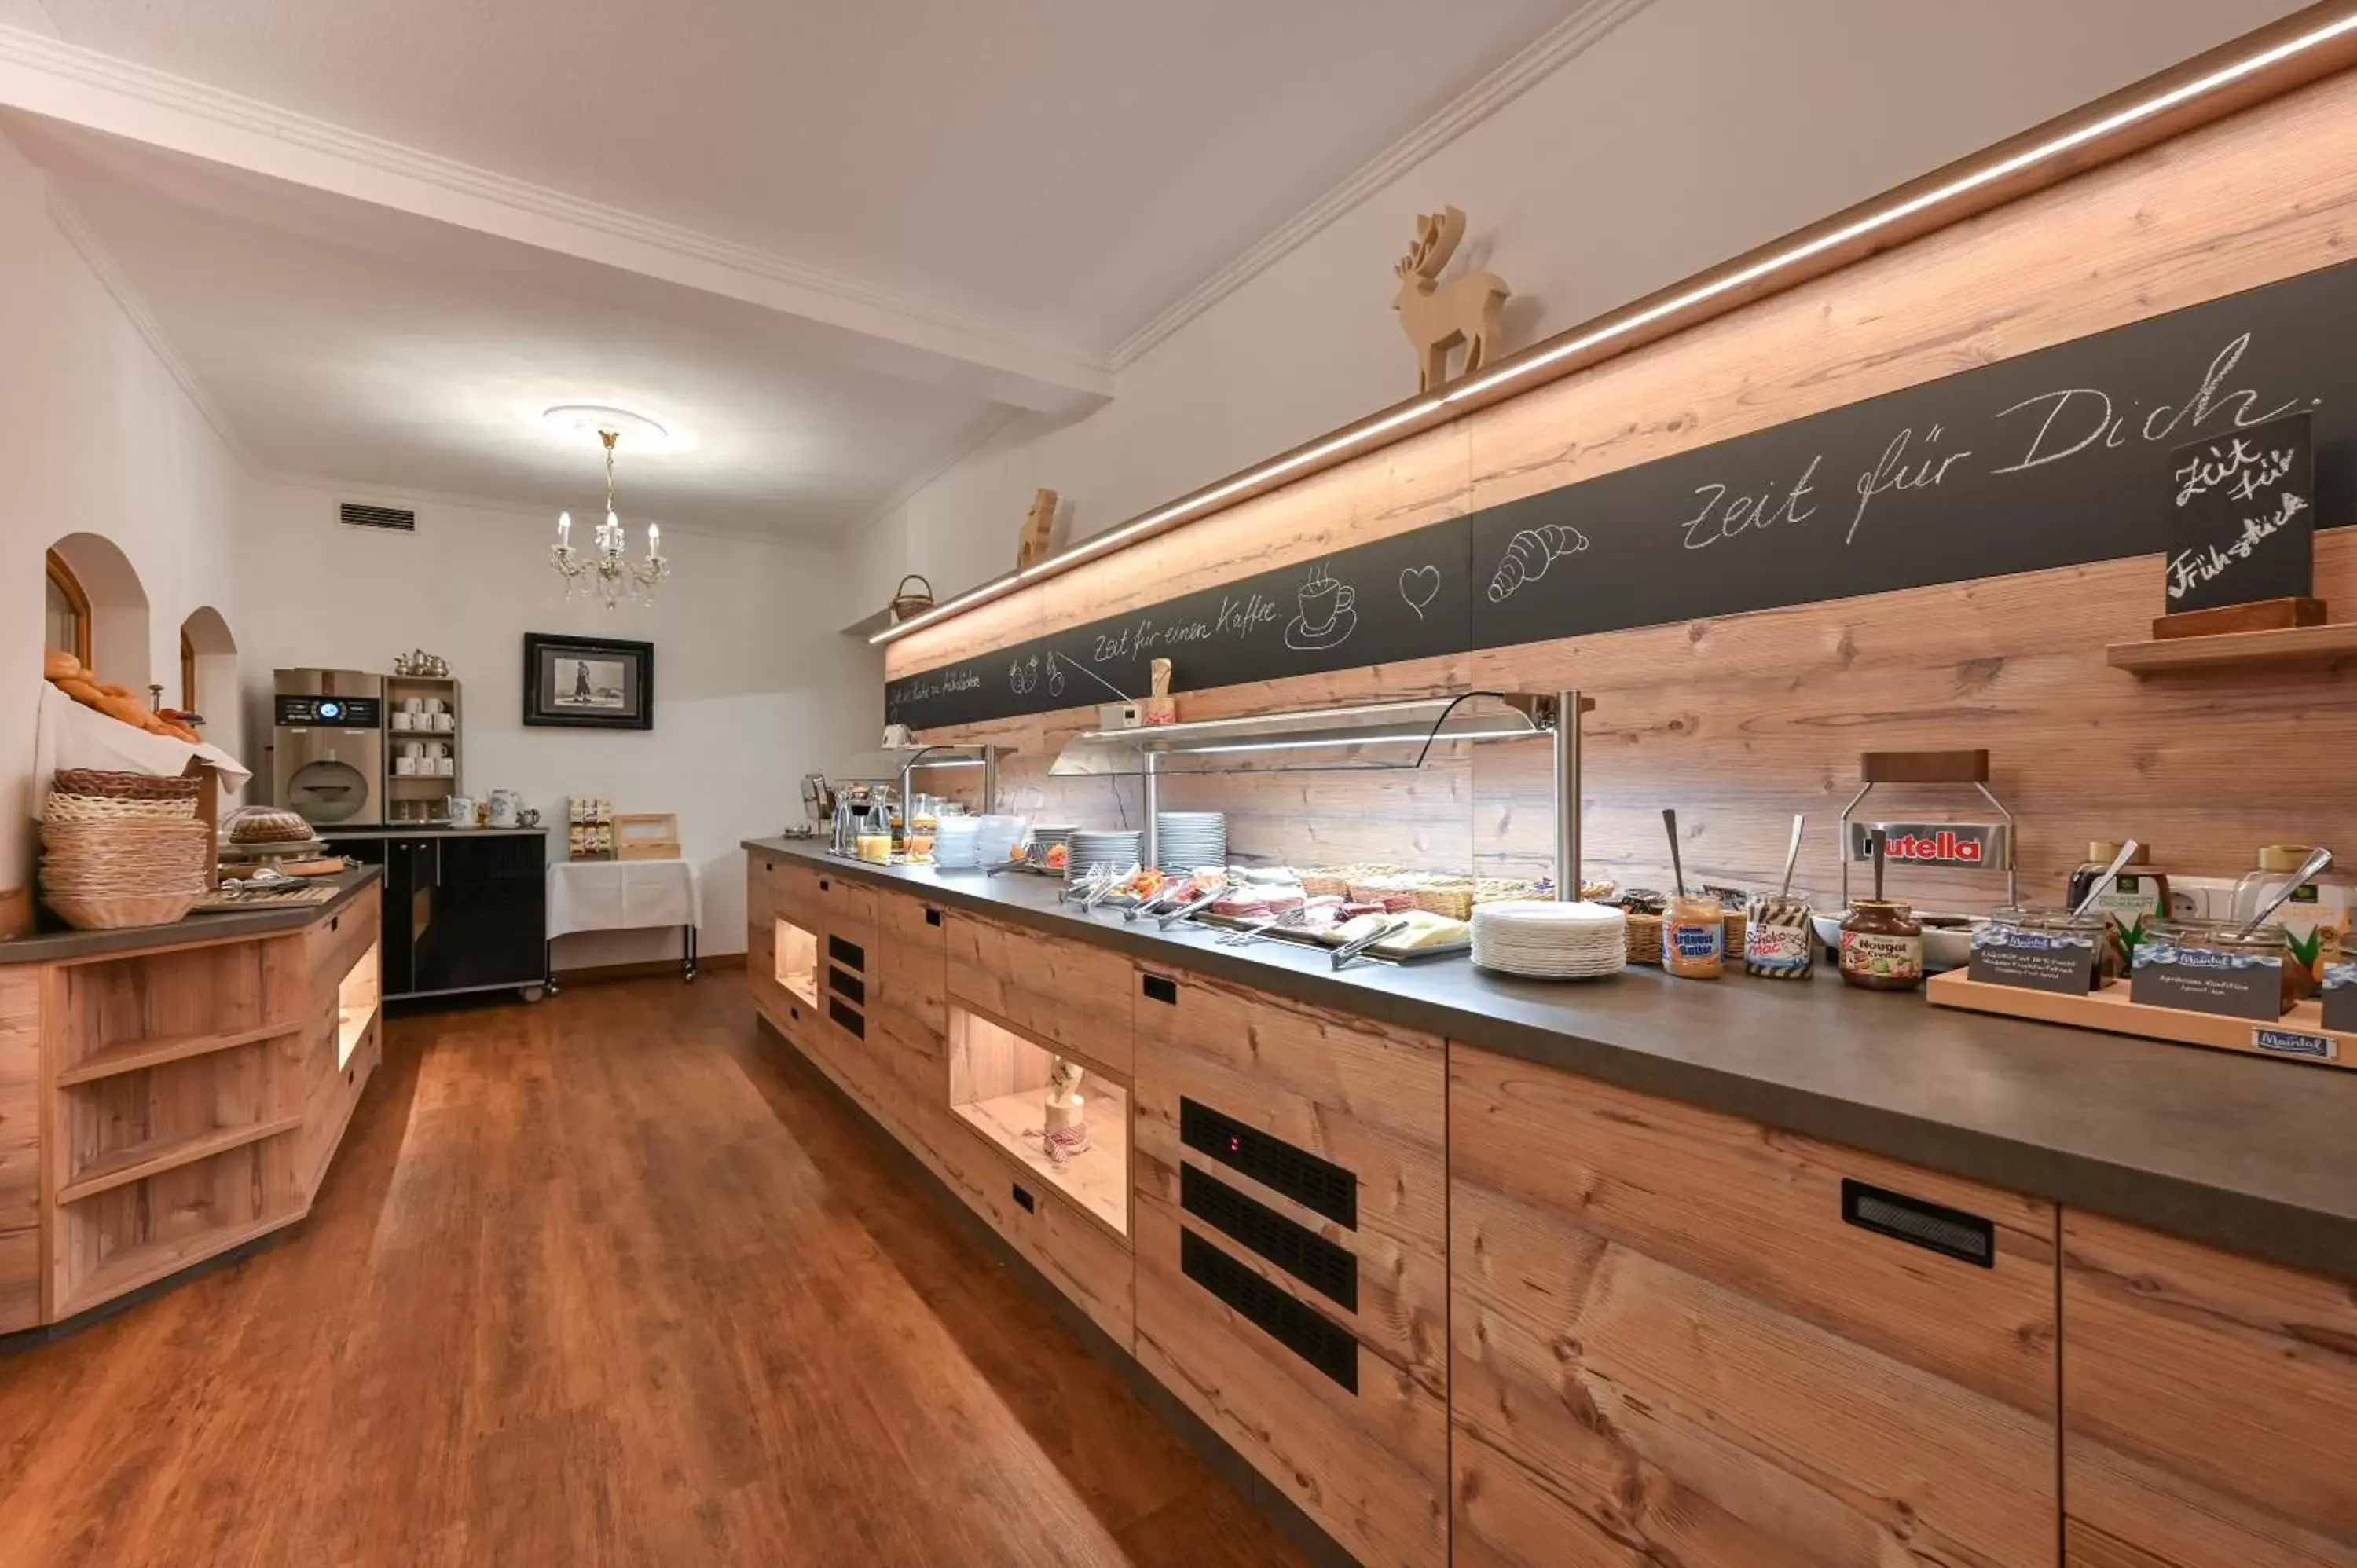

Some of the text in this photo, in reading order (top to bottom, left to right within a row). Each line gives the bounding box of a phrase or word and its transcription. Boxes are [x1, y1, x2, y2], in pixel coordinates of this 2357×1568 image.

[1681, 454, 1823, 550] Zeit
[1846, 423, 1972, 545] für
[2175, 438, 2262, 507] Zeit
[2227, 447, 2295, 501] für
[1133, 620, 1160, 661] für
[1163, 621, 1211, 645] einen
[1860, 939, 1907, 953] Nougat
